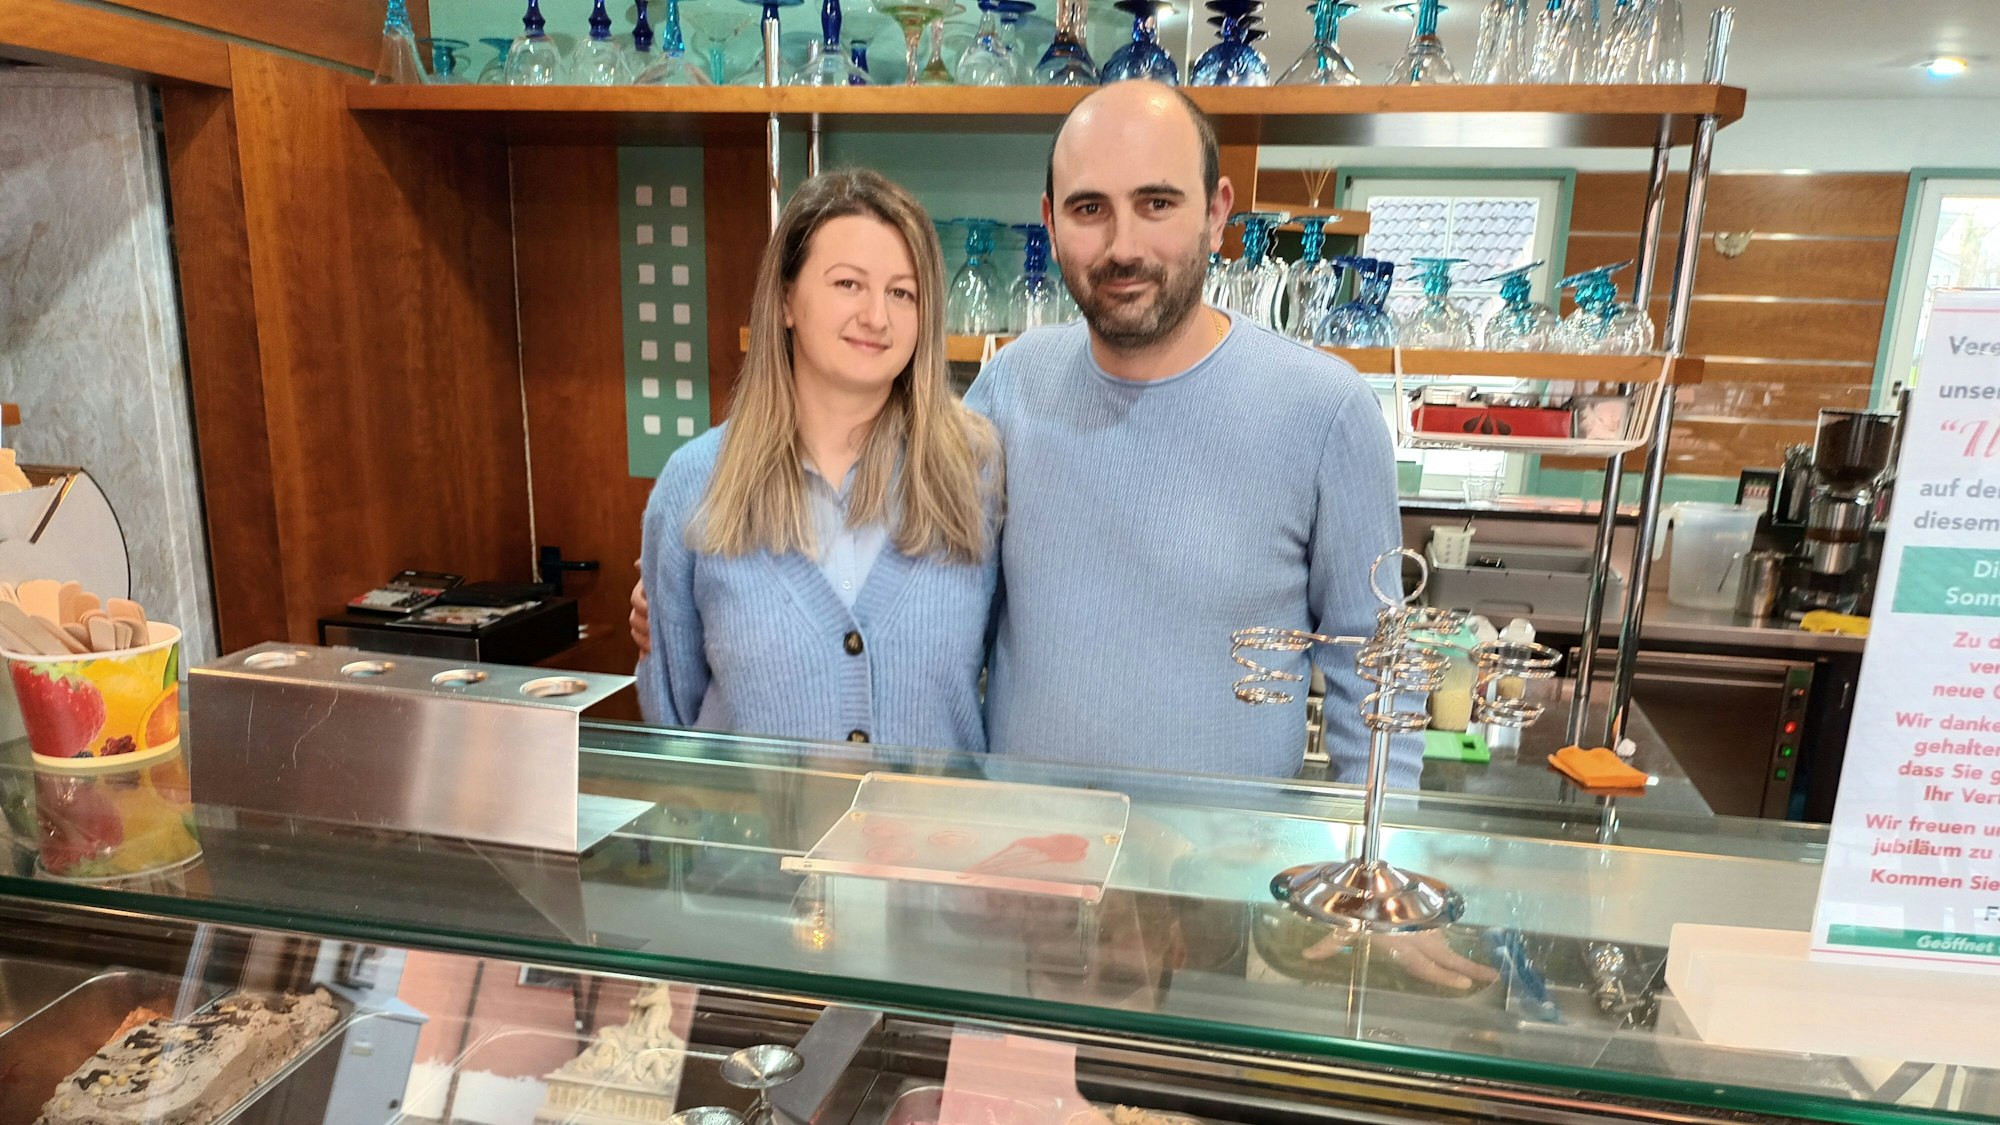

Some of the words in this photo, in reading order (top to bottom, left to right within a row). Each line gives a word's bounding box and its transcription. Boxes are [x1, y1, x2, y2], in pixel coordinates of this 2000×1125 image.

[1920, 478, 1961, 497] auf
[1966, 479, 2000, 499] de
[1914, 510, 2000, 532] diesem
[1953, 631, 1981, 648] Zu
[1933, 685, 1985, 699] neue
[1896, 711, 1933, 728] Wir
[1898, 760, 1944, 778] dass
[1951, 763, 1983, 780] Sie
[1923, 784, 1954, 801] Ihr
[1866, 813, 1902, 830] Wir
[1908, 816, 1976, 835] freuen
[1872, 838, 1962, 857] jubiläum
[1968, 847, 1993, 859] zu
[1870, 868, 1963, 888] Kommen
[1970, 876, 2000, 891] Sie
[1916, 934, 1994, 954] Geöffnet
